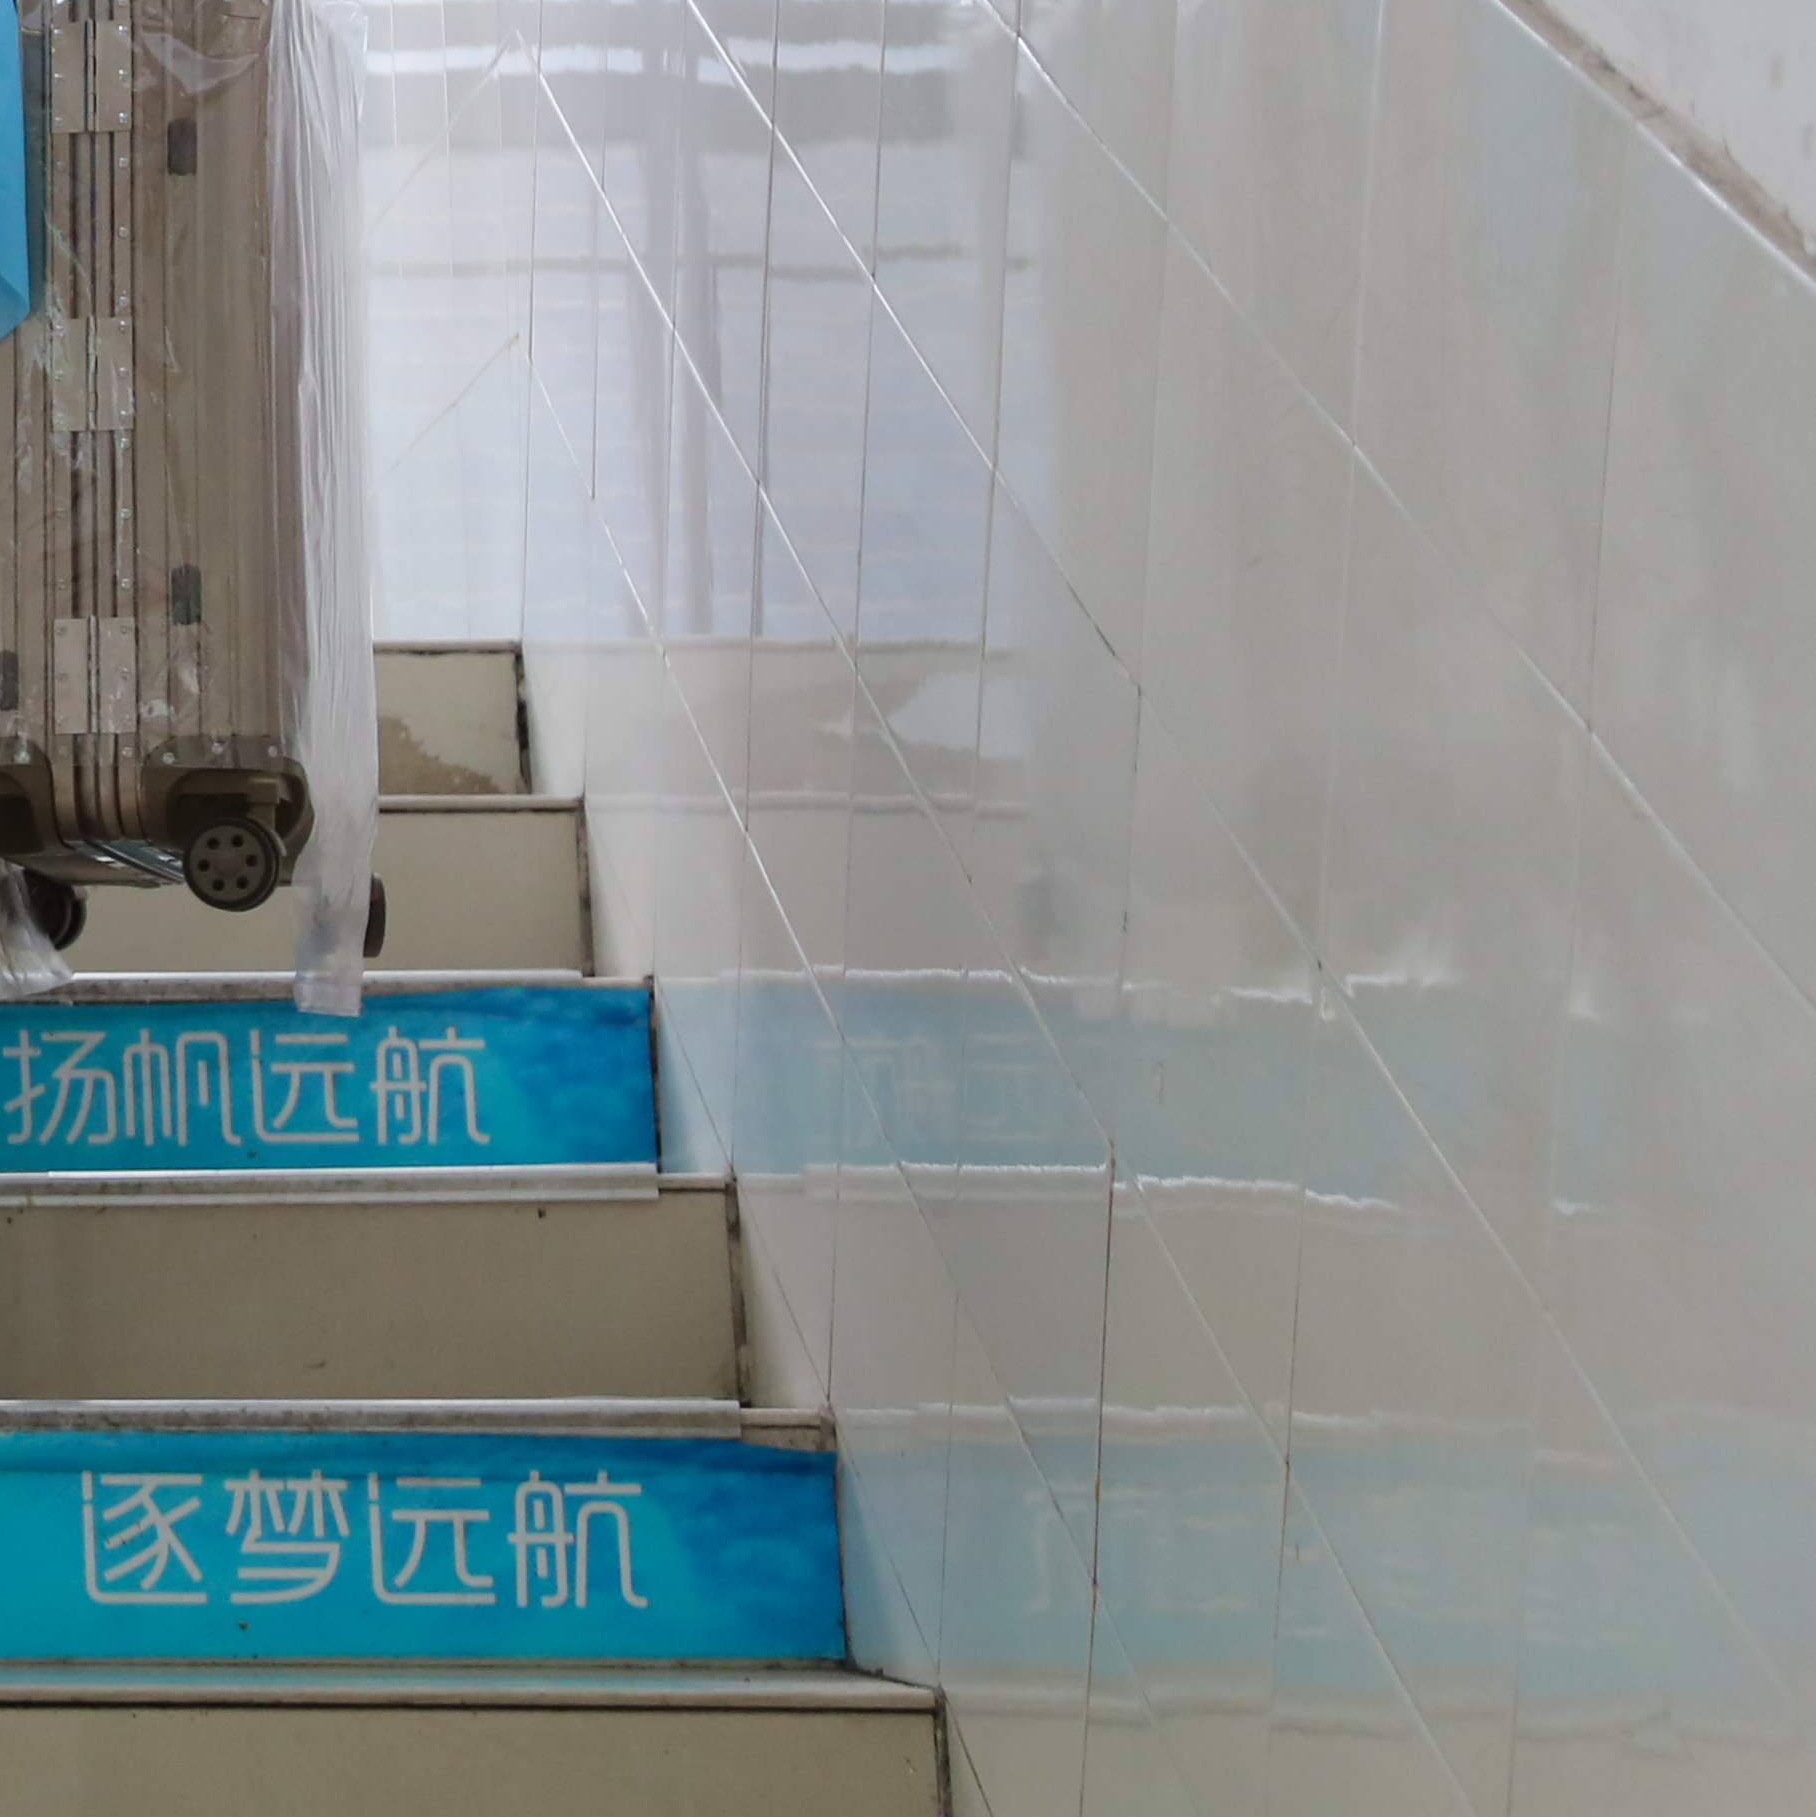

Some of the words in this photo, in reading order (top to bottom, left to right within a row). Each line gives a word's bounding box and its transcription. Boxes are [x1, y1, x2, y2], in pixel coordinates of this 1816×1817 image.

[2, 1025, 490, 1145] 扬帆远航
[82, 1469, 648, 1609] 逐梦远航
